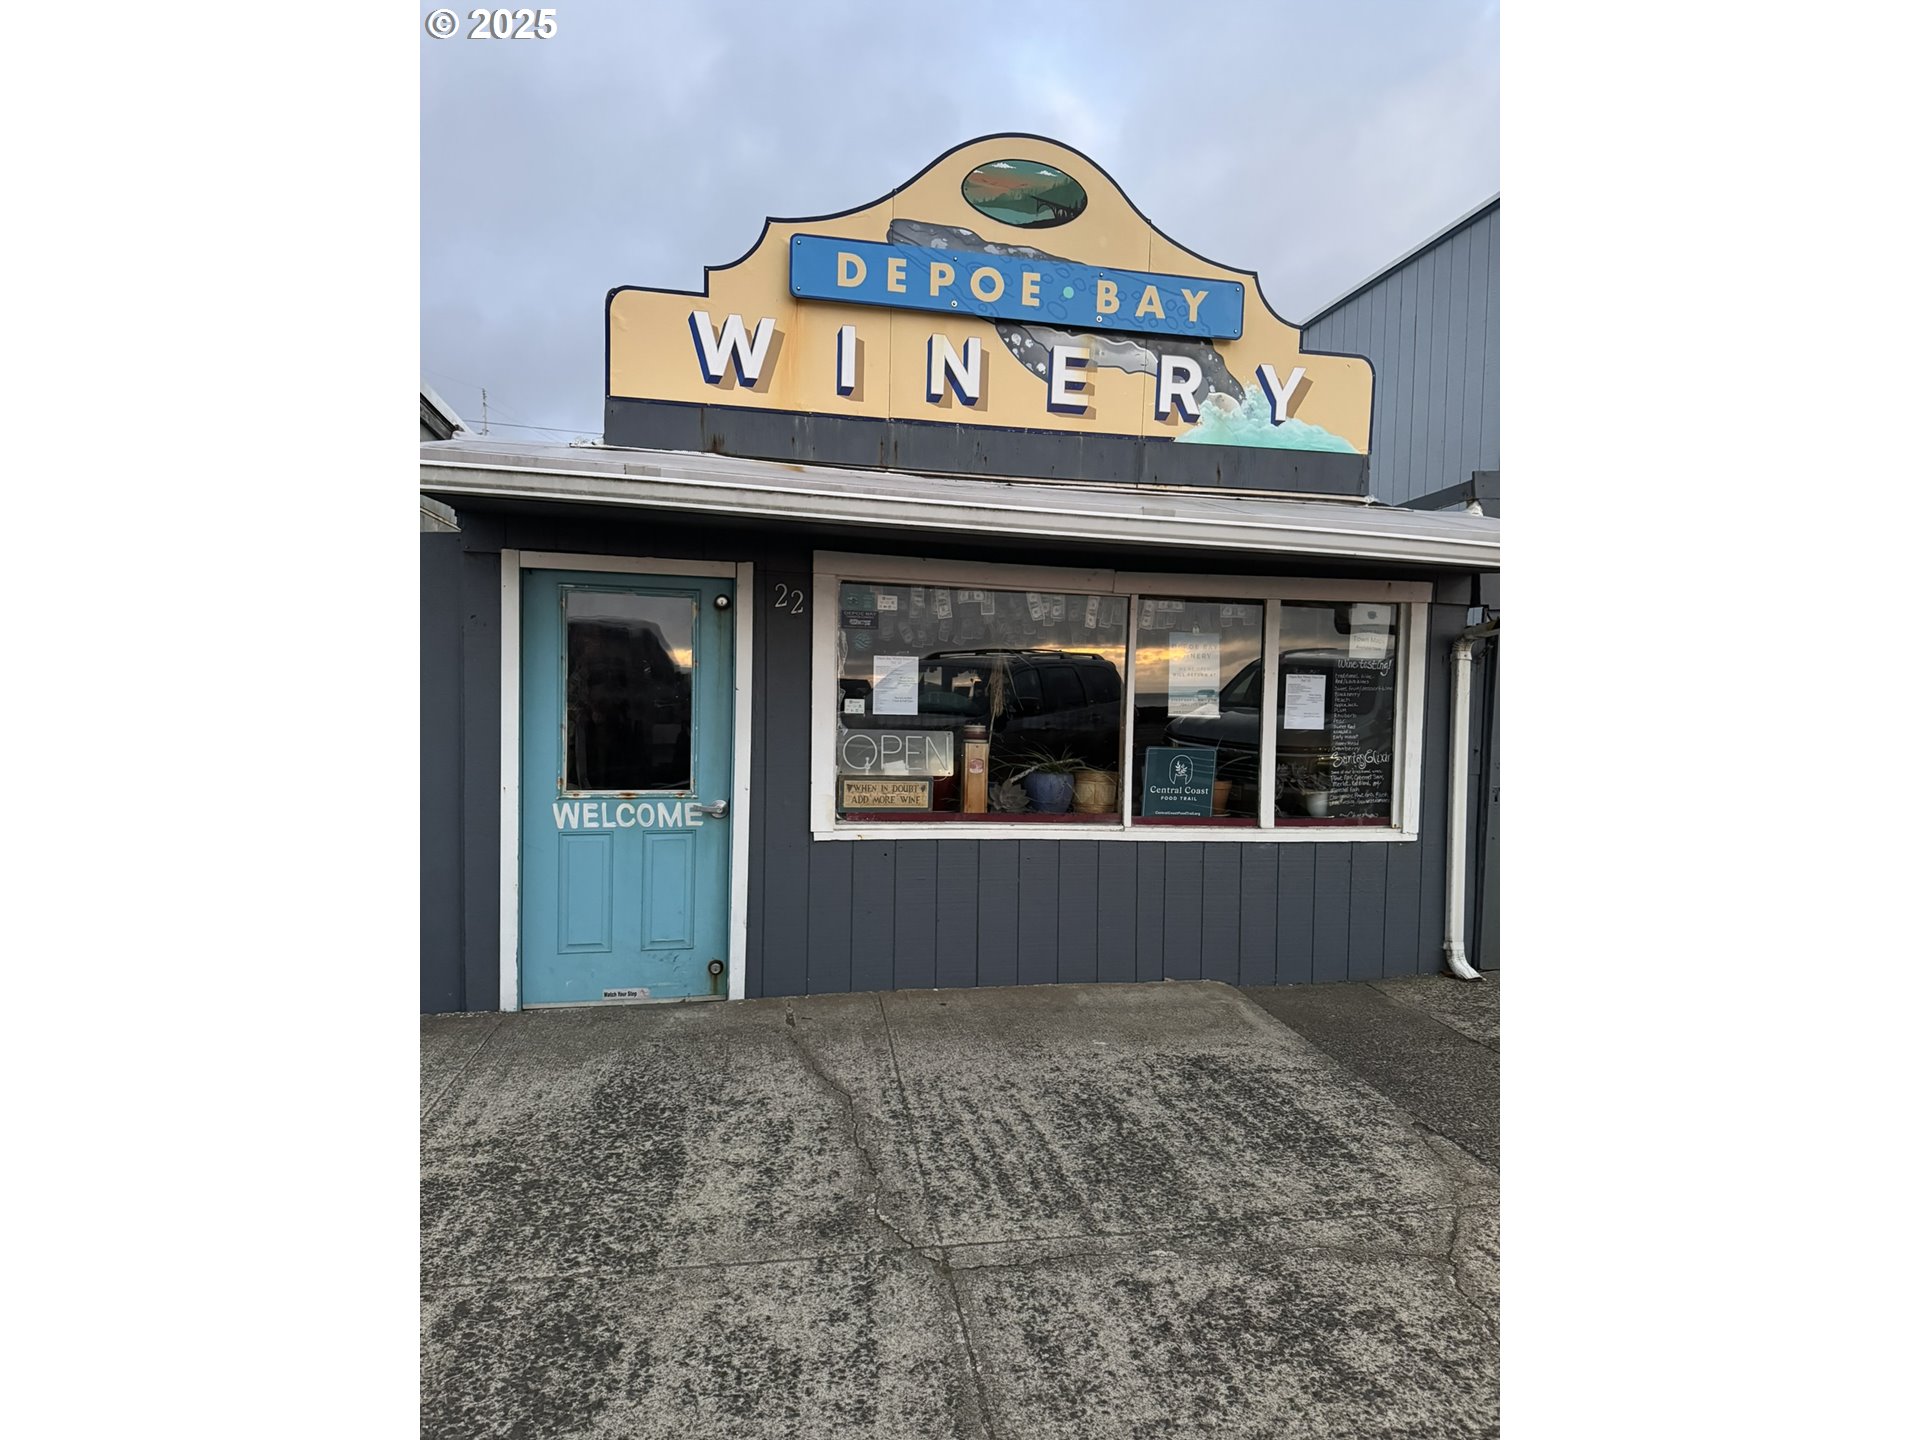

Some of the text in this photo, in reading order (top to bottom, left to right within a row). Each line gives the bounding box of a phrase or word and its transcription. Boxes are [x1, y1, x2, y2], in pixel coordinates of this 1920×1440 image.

[835, 250, 1210, 322] DEPOE BAY
[688, 310, 1308, 424] WINERY
[774, 583, 804, 614] 22
[1338, 658, 1359, 668] Wine
[843, 734, 950, 771] OPEN
[851, 795, 921, 804] ADD MORE WINE
[853, 784, 920, 792] WHEN IN DOUBT
[1150, 786, 1209, 794] Central Coast
[552, 801, 704, 829] WELCOME
